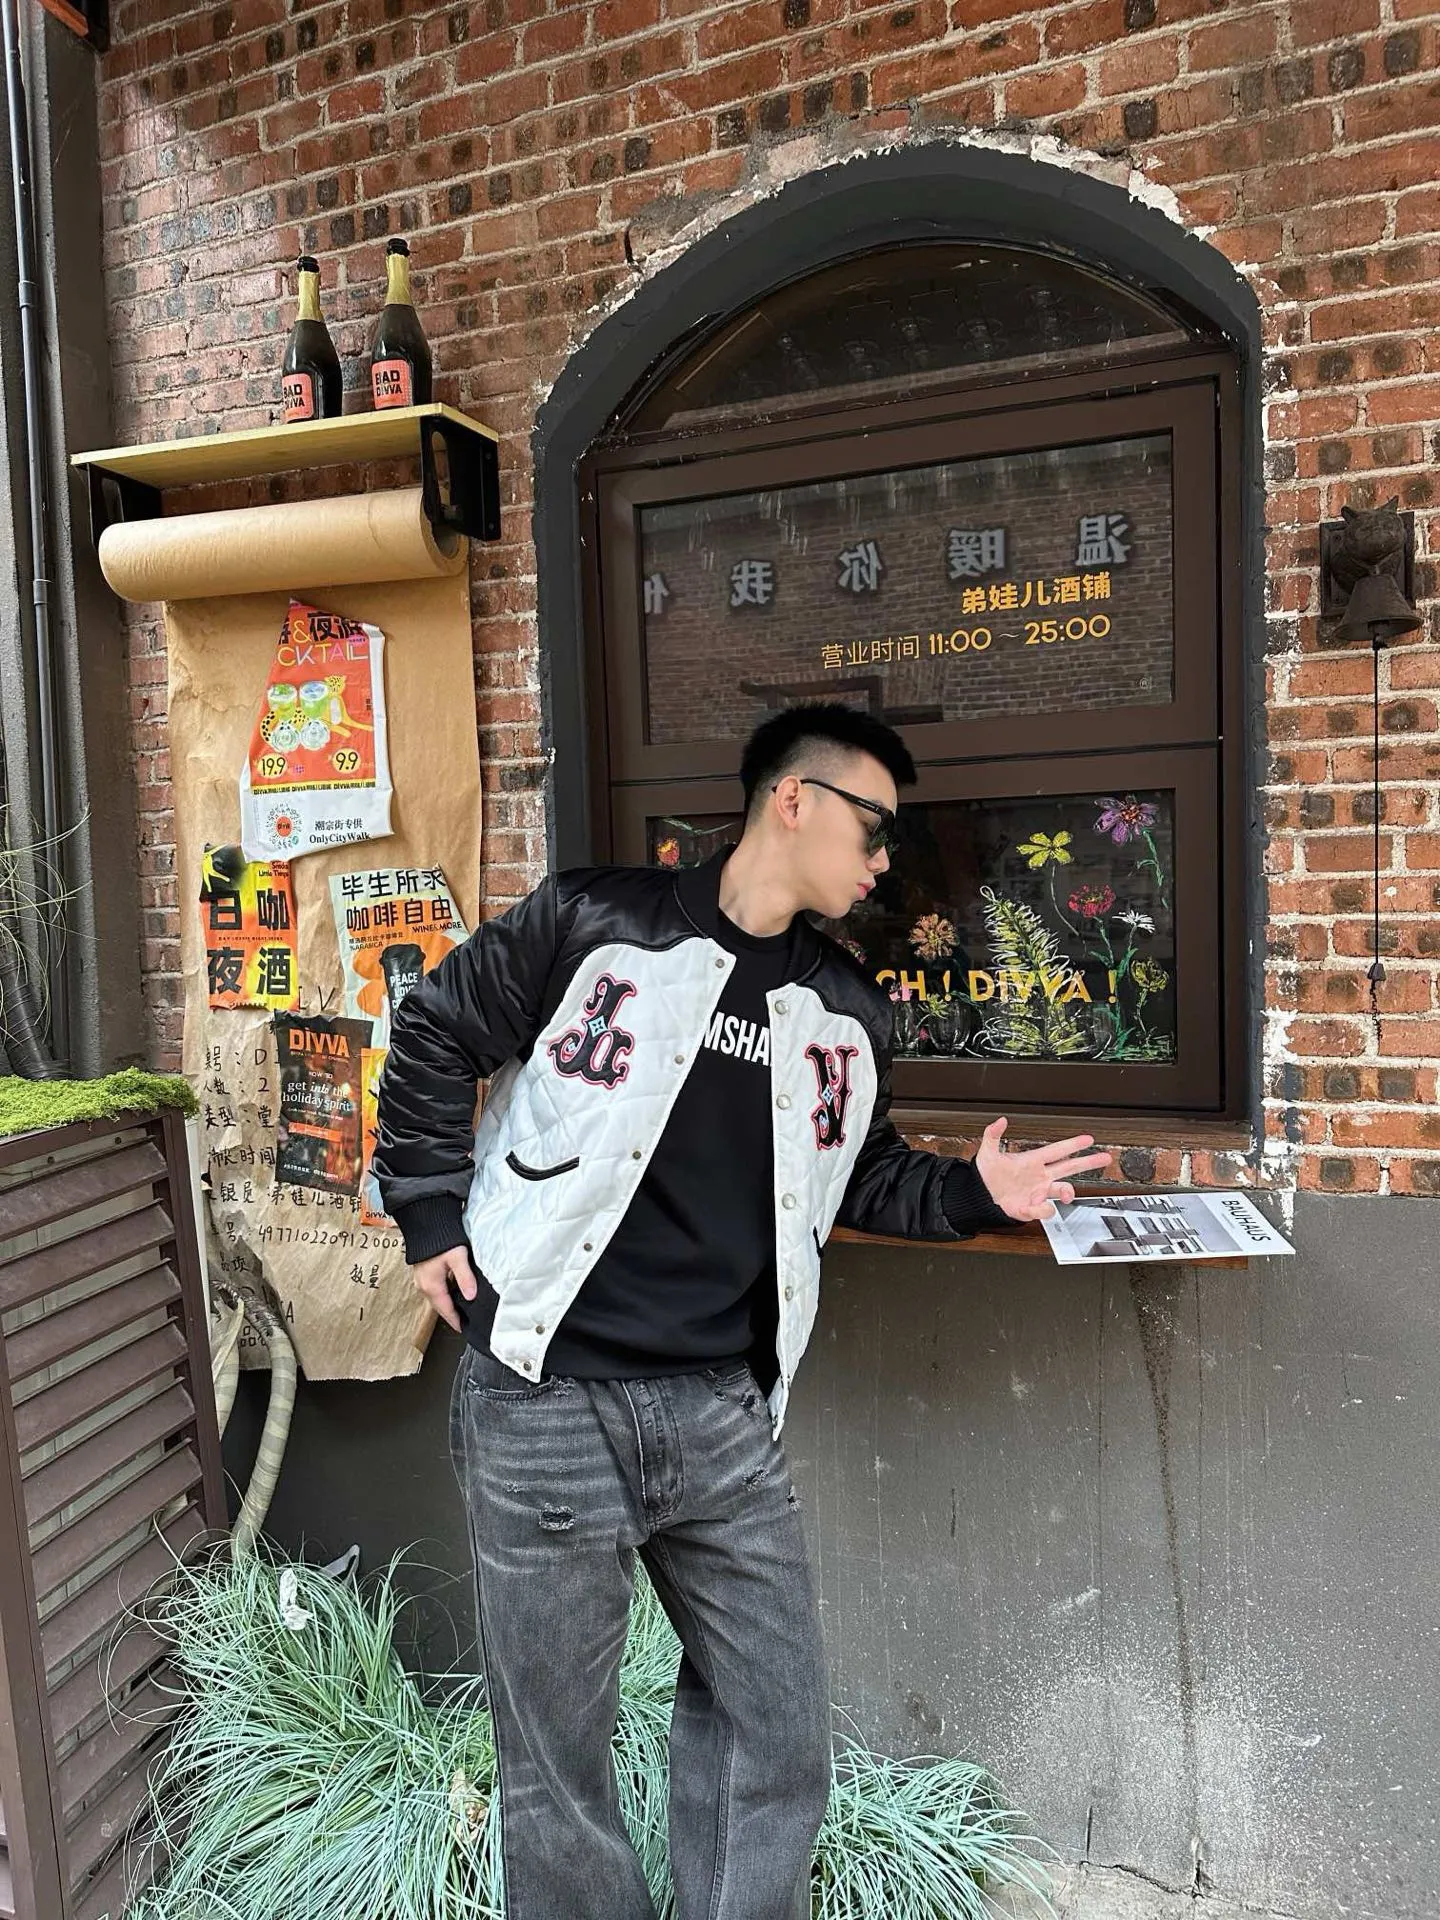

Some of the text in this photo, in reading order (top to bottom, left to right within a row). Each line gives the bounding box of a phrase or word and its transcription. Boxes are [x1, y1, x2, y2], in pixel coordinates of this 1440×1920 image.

[375, 370, 400, 385] BAD
[962, 571, 1111, 615] 弟娃儿酒铺
[821, 636, 920, 669] 营业时间
[929, 627, 992, 655] 11:00
[1024, 614, 1111, 645] 25:00
[261, 757, 286, 775] 19.9
[336, 751, 359, 770] 9.9
[315, 818, 363, 831] 潮宗街专供
[341, 869, 446, 901] 毕生所求
[346, 895, 453, 932] 咖啡自由
[207, 946, 291, 996] 夜酒
[390, 972, 418, 987] PEACE
[287, 1081, 307, 1092] get
[282, 1091, 323, 1108] holiday
[1221, 1199, 1272, 1242] BAUHAUS
[350, 1263, 381, 1290] 数量
